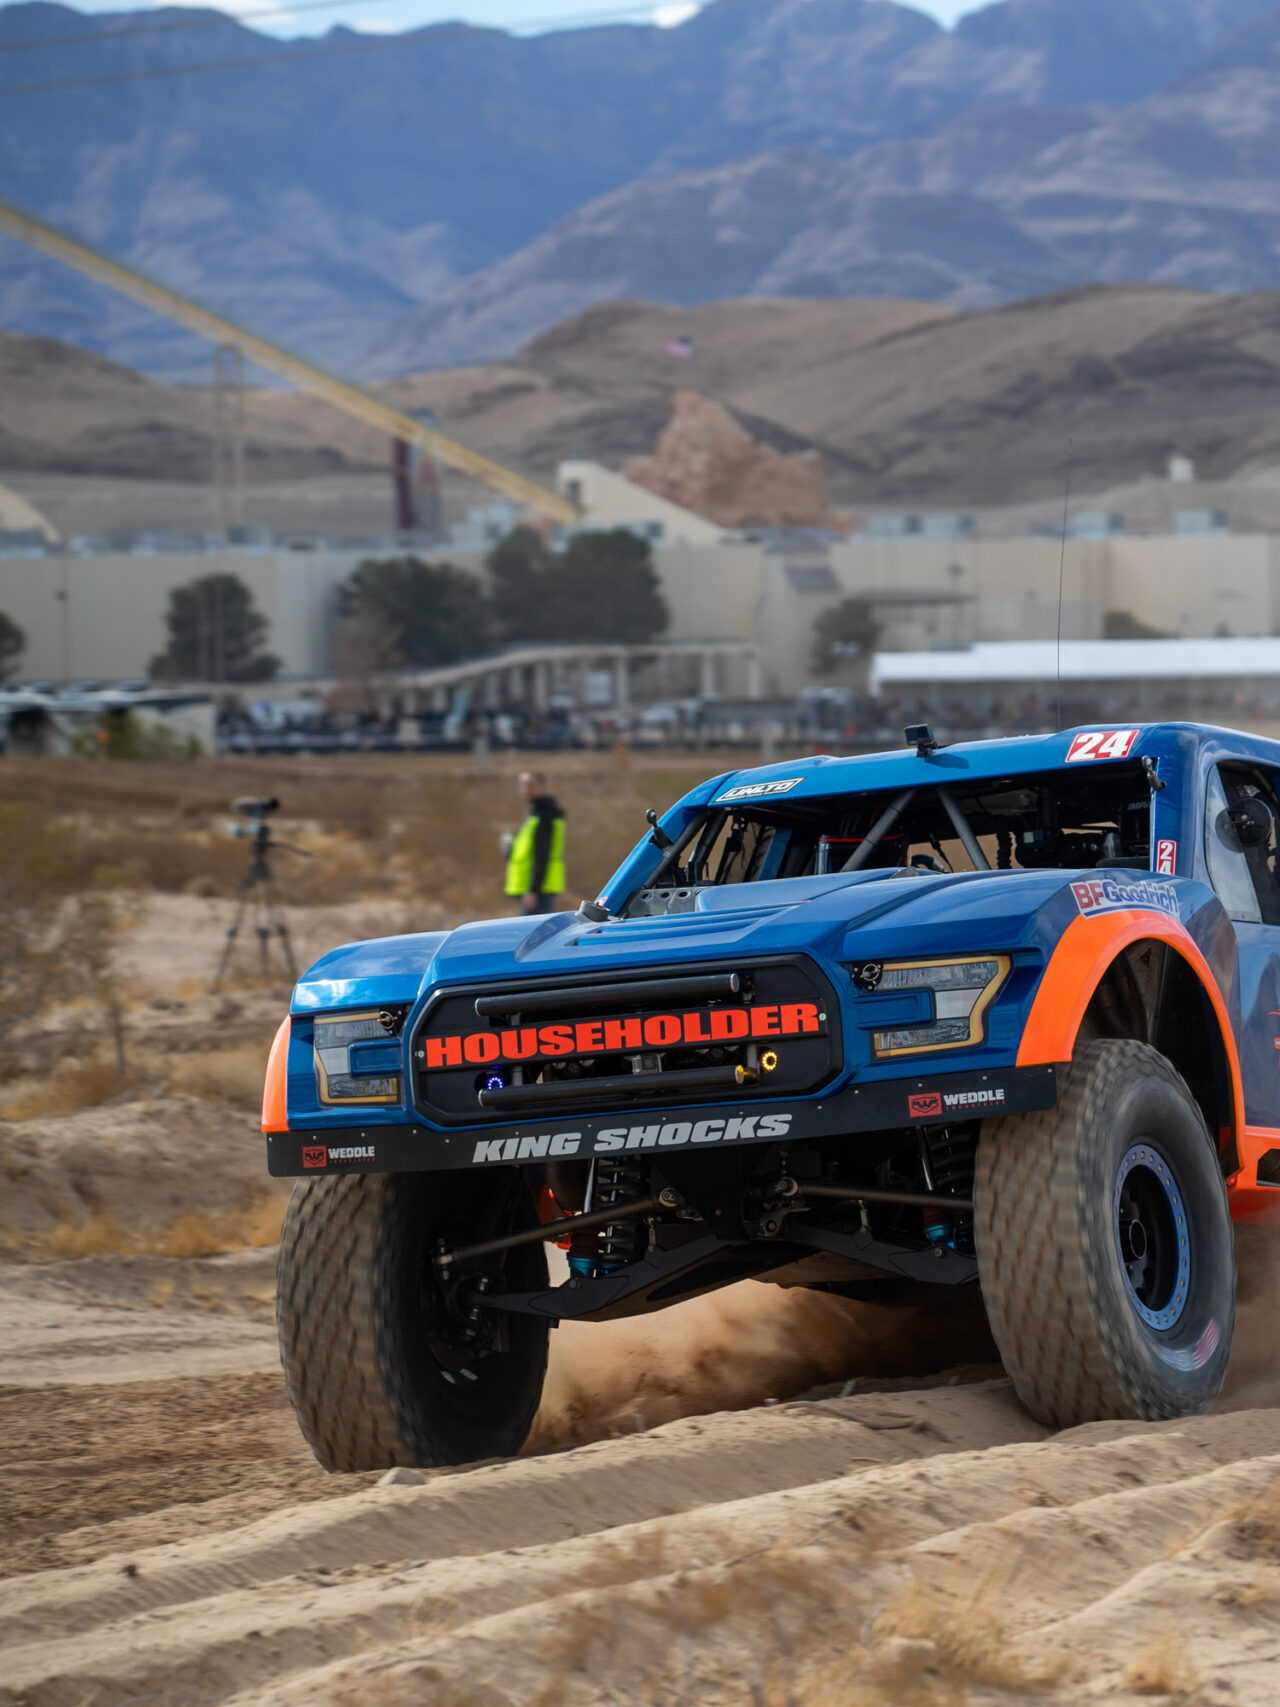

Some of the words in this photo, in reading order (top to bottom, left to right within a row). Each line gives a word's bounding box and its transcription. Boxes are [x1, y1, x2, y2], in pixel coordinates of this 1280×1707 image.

[1069, 731, 1128, 760] 24
[1071, 880, 1179, 913] BFGoodrich
[425, 1003, 820, 1069] HOUSEHOLDER
[944, 1089, 1005, 1106] WEDDLE
[328, 1146, 375, 1159] WEDDLE
[472, 1132, 582, 1163] KING
[594, 1114, 793, 1151] SHOCKS
